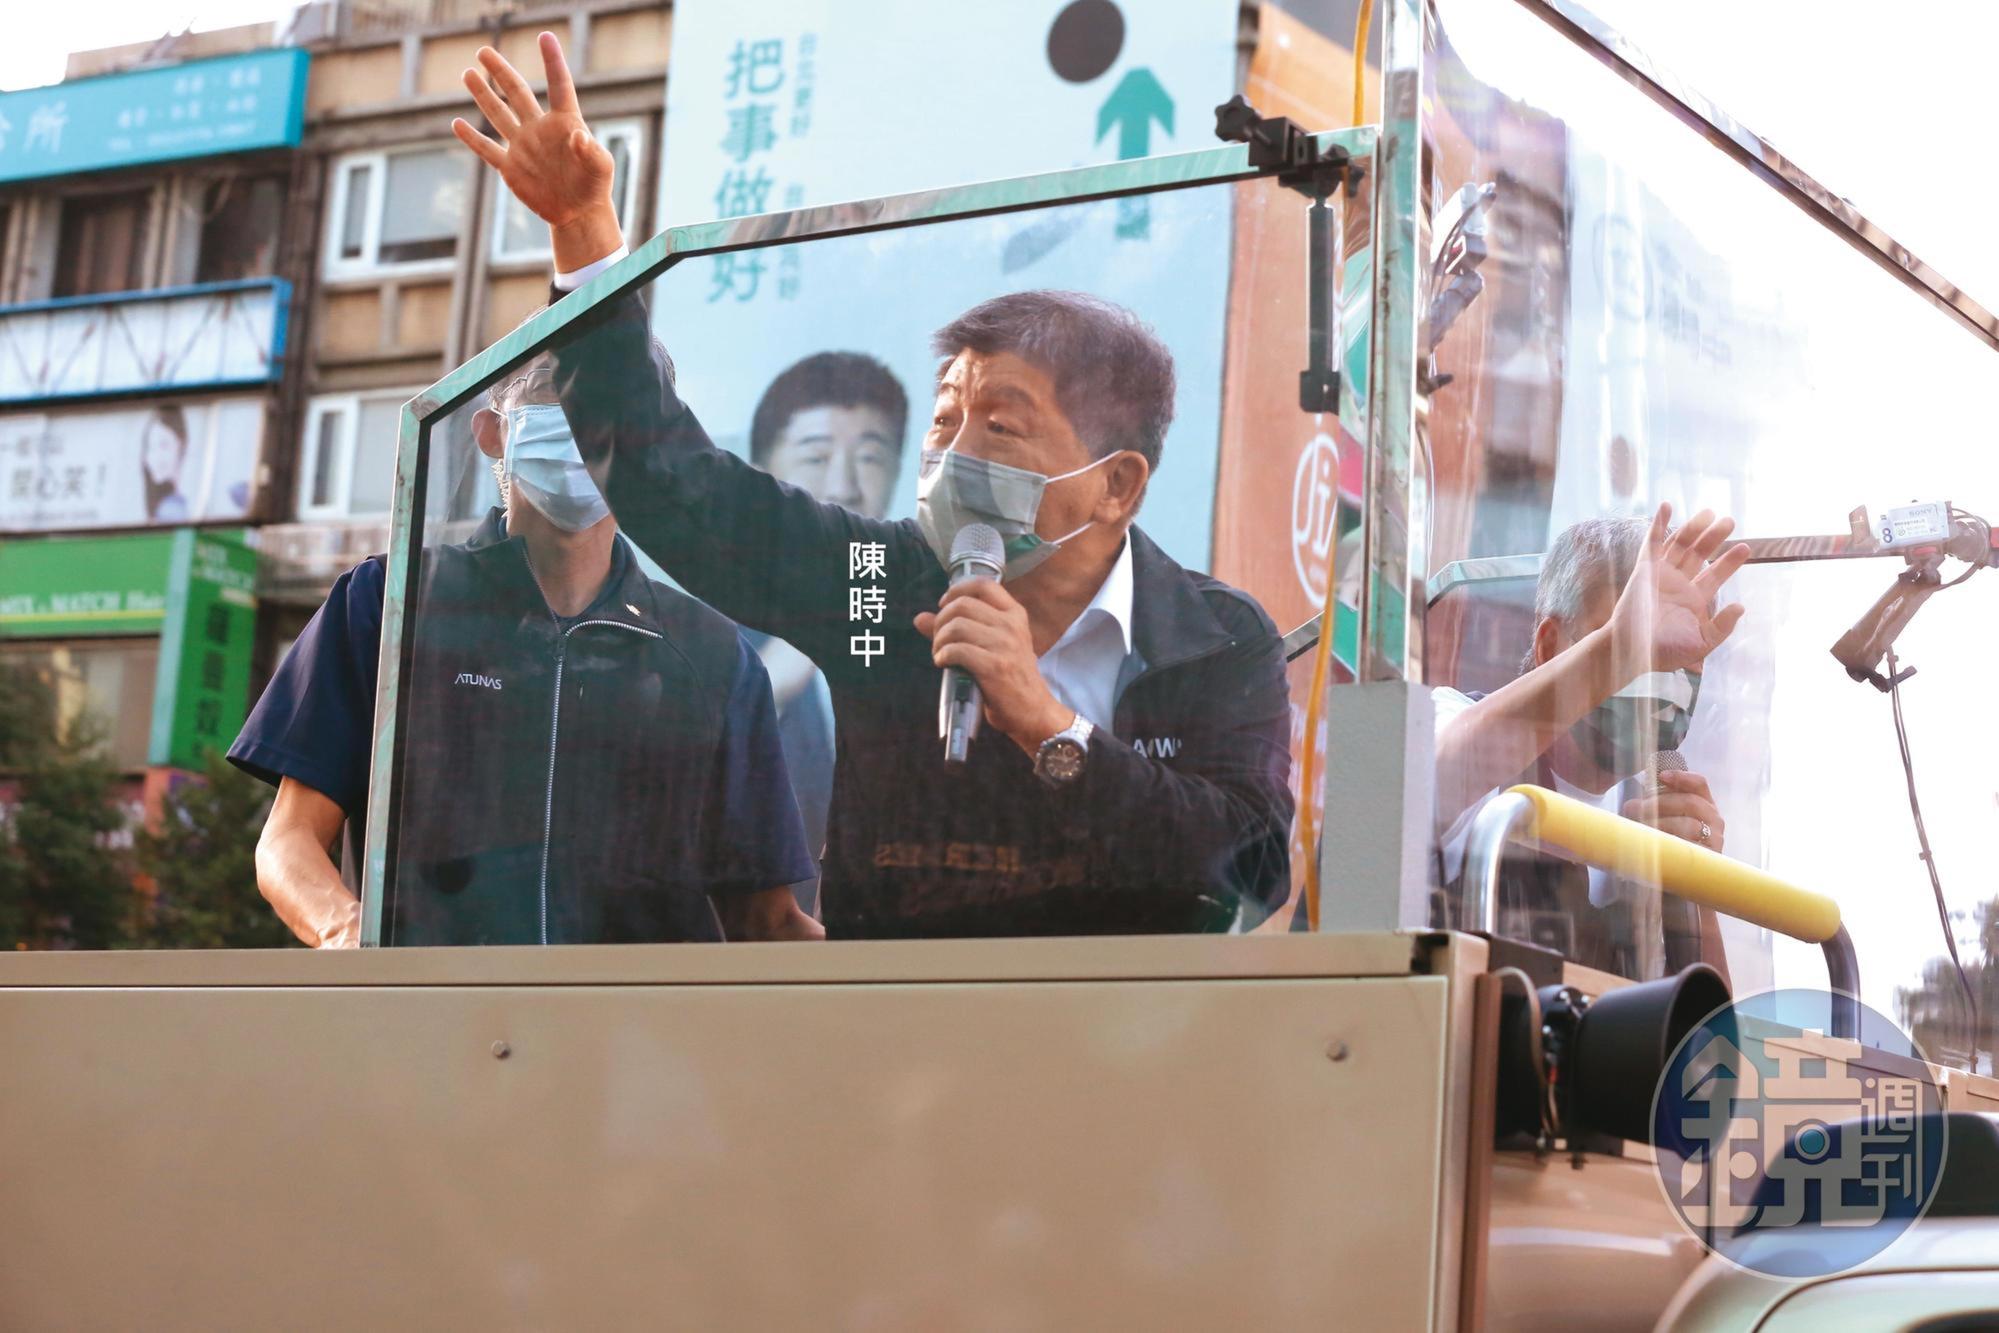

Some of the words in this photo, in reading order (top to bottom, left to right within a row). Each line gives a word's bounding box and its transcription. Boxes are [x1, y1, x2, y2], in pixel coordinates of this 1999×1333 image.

[705, 37, 785, 304] 把事做好
[1882, 527, 1893, 543] 8
[454, 673, 502, 690] ATUNAS
